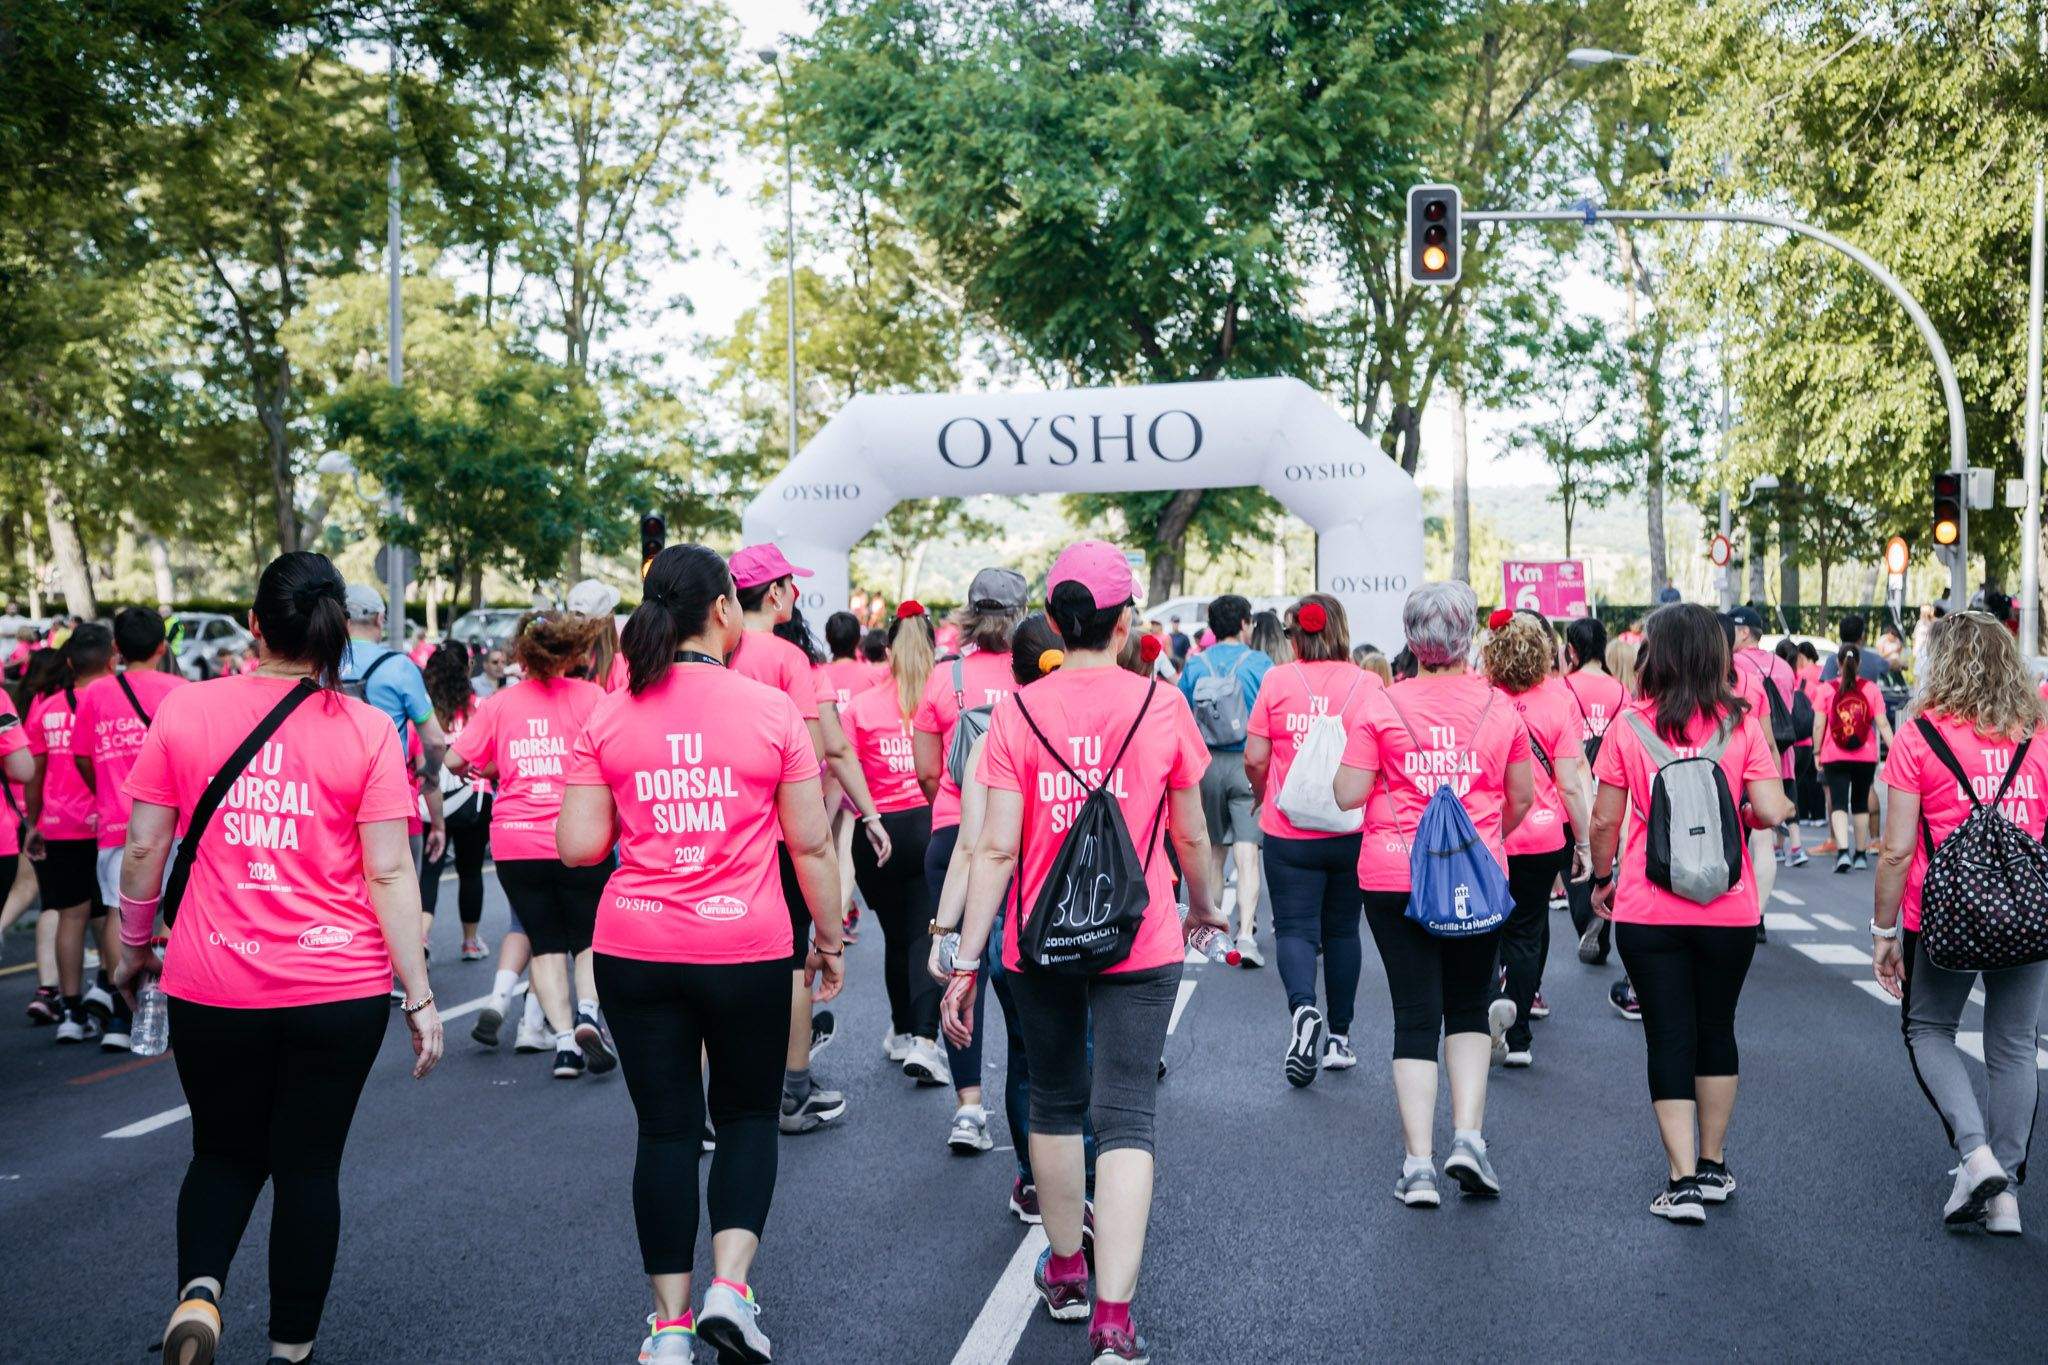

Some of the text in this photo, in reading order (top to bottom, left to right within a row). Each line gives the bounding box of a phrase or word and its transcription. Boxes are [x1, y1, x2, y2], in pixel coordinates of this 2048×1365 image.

[938, 409, 1204, 469] OYSHO
[1285, 462, 1365, 480] OYSHO
[782, 484, 860, 501] OYSHO
[1331, 575, 1407, 593] OYSHO
[1510, 563, 1543, 583] Km
[1516, 584, 1540, 612] 6
[527, 718, 549, 738] TU
[1429, 726, 1456, 750] TU
[509, 737, 568, 759] DORSAL
[666, 733, 703, 765] TU
[880, 737, 913, 755] DOR
[1068, 736, 1101, 767] TU
[517, 757, 563, 778] SUMA
[1404, 750, 1482, 774] DORSAL
[1981, 748, 2010, 773] TU
[635, 766, 739, 802] DORSAL
[652, 800, 727, 834] SUMA
[1051, 803, 1085, 834] SU
[223, 811, 300, 851] SUMA
[674, 846, 705, 864] 2024
[616, 896, 663, 913] OYSHO
